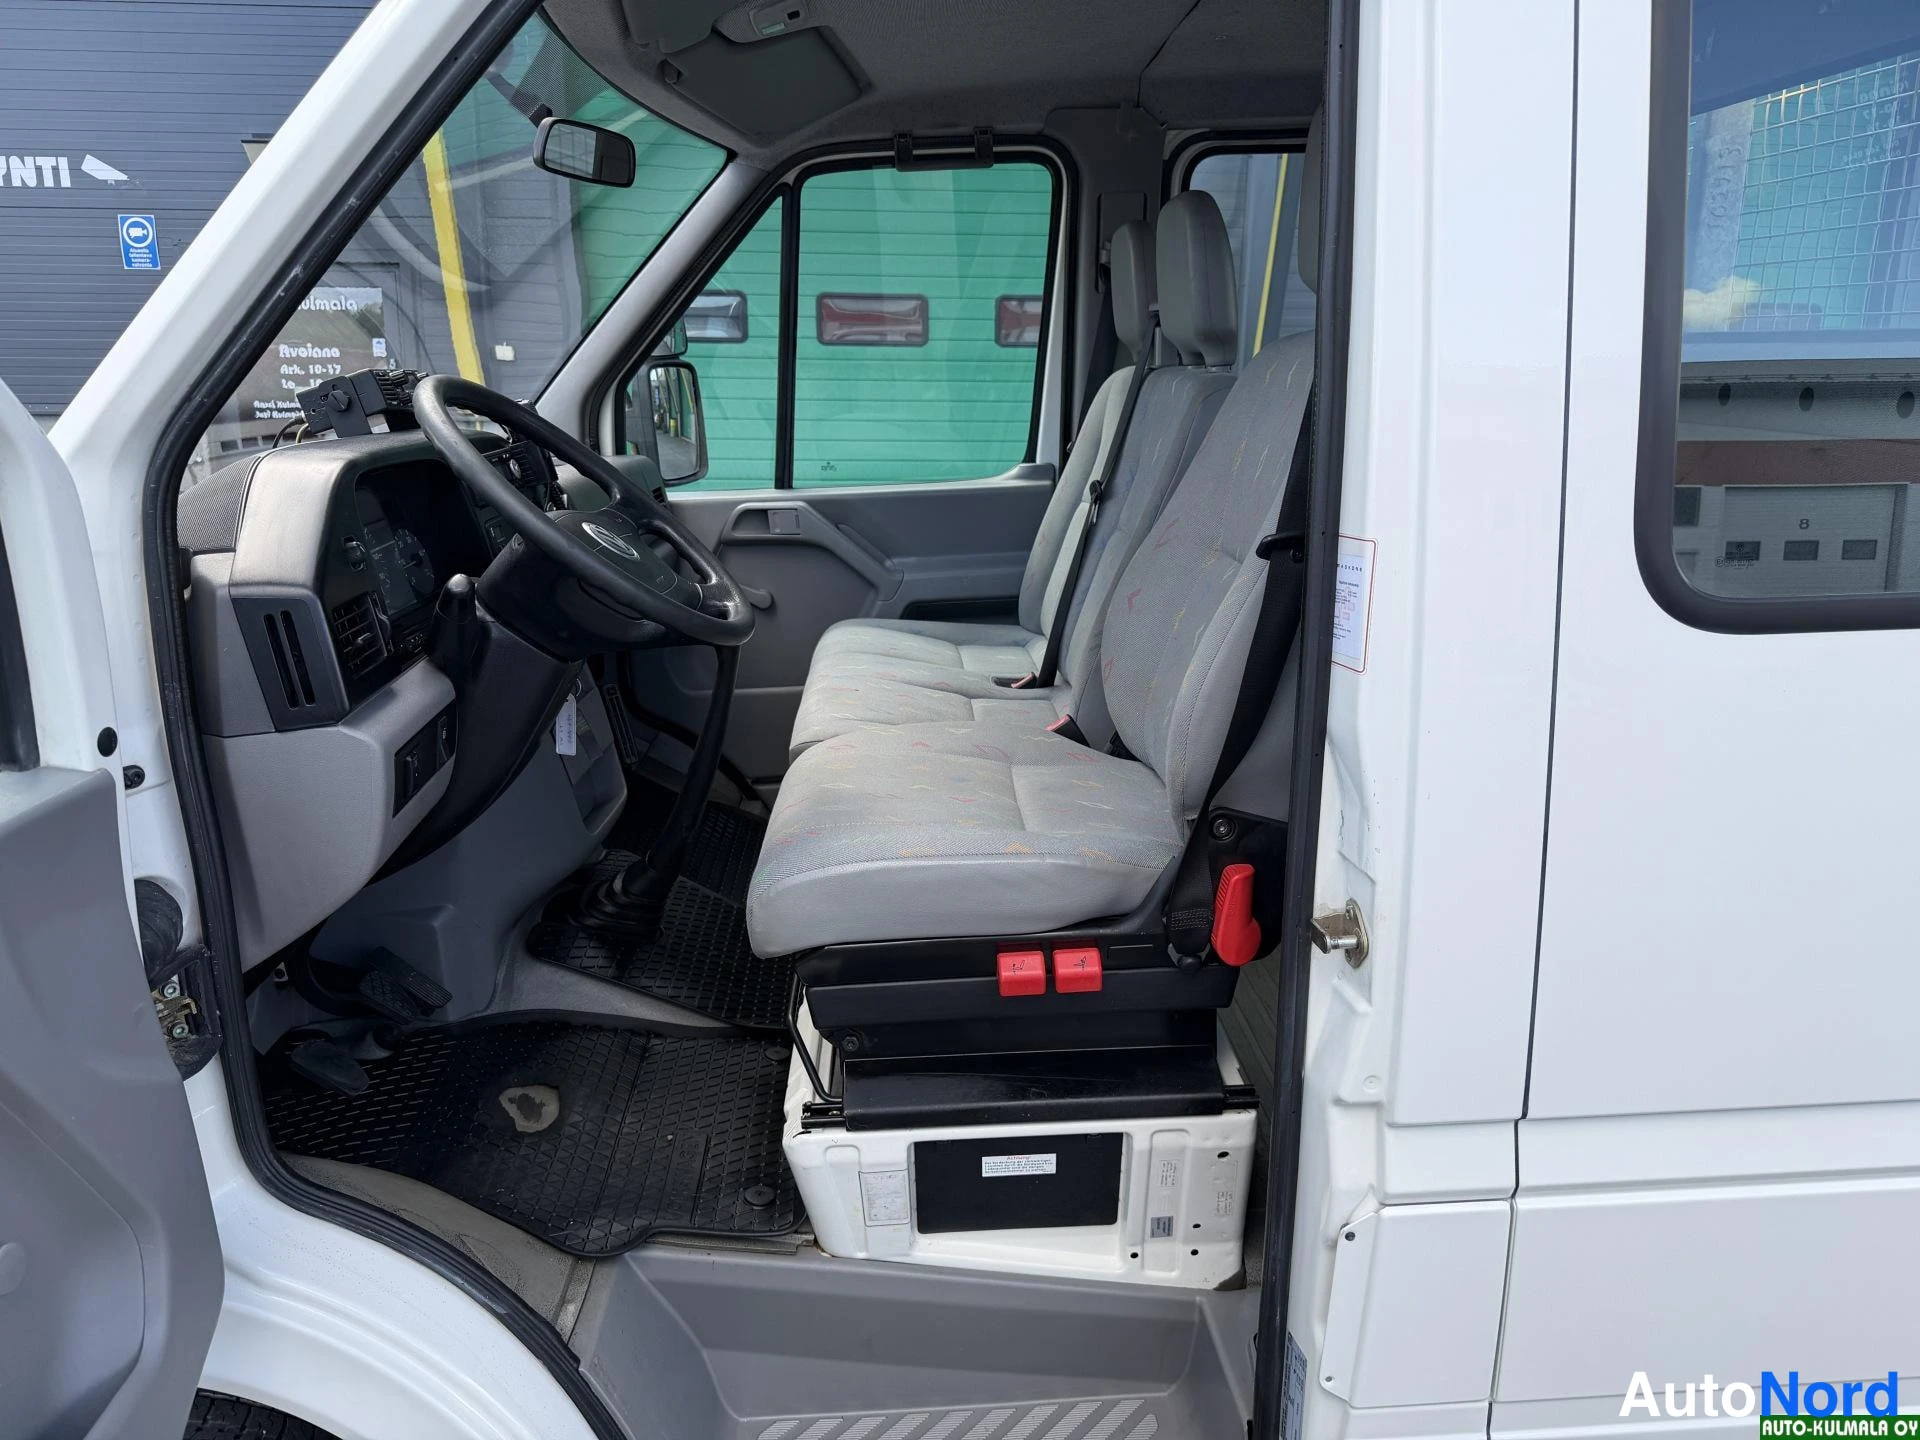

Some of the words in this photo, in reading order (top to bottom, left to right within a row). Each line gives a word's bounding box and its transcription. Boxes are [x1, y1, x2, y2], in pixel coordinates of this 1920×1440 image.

[297, 295, 358, 311] ulmala
[280, 363, 305, 375] Ark.
[308, 363, 342, 375] 10-17
[1798, 518, 1810, 530] 8
